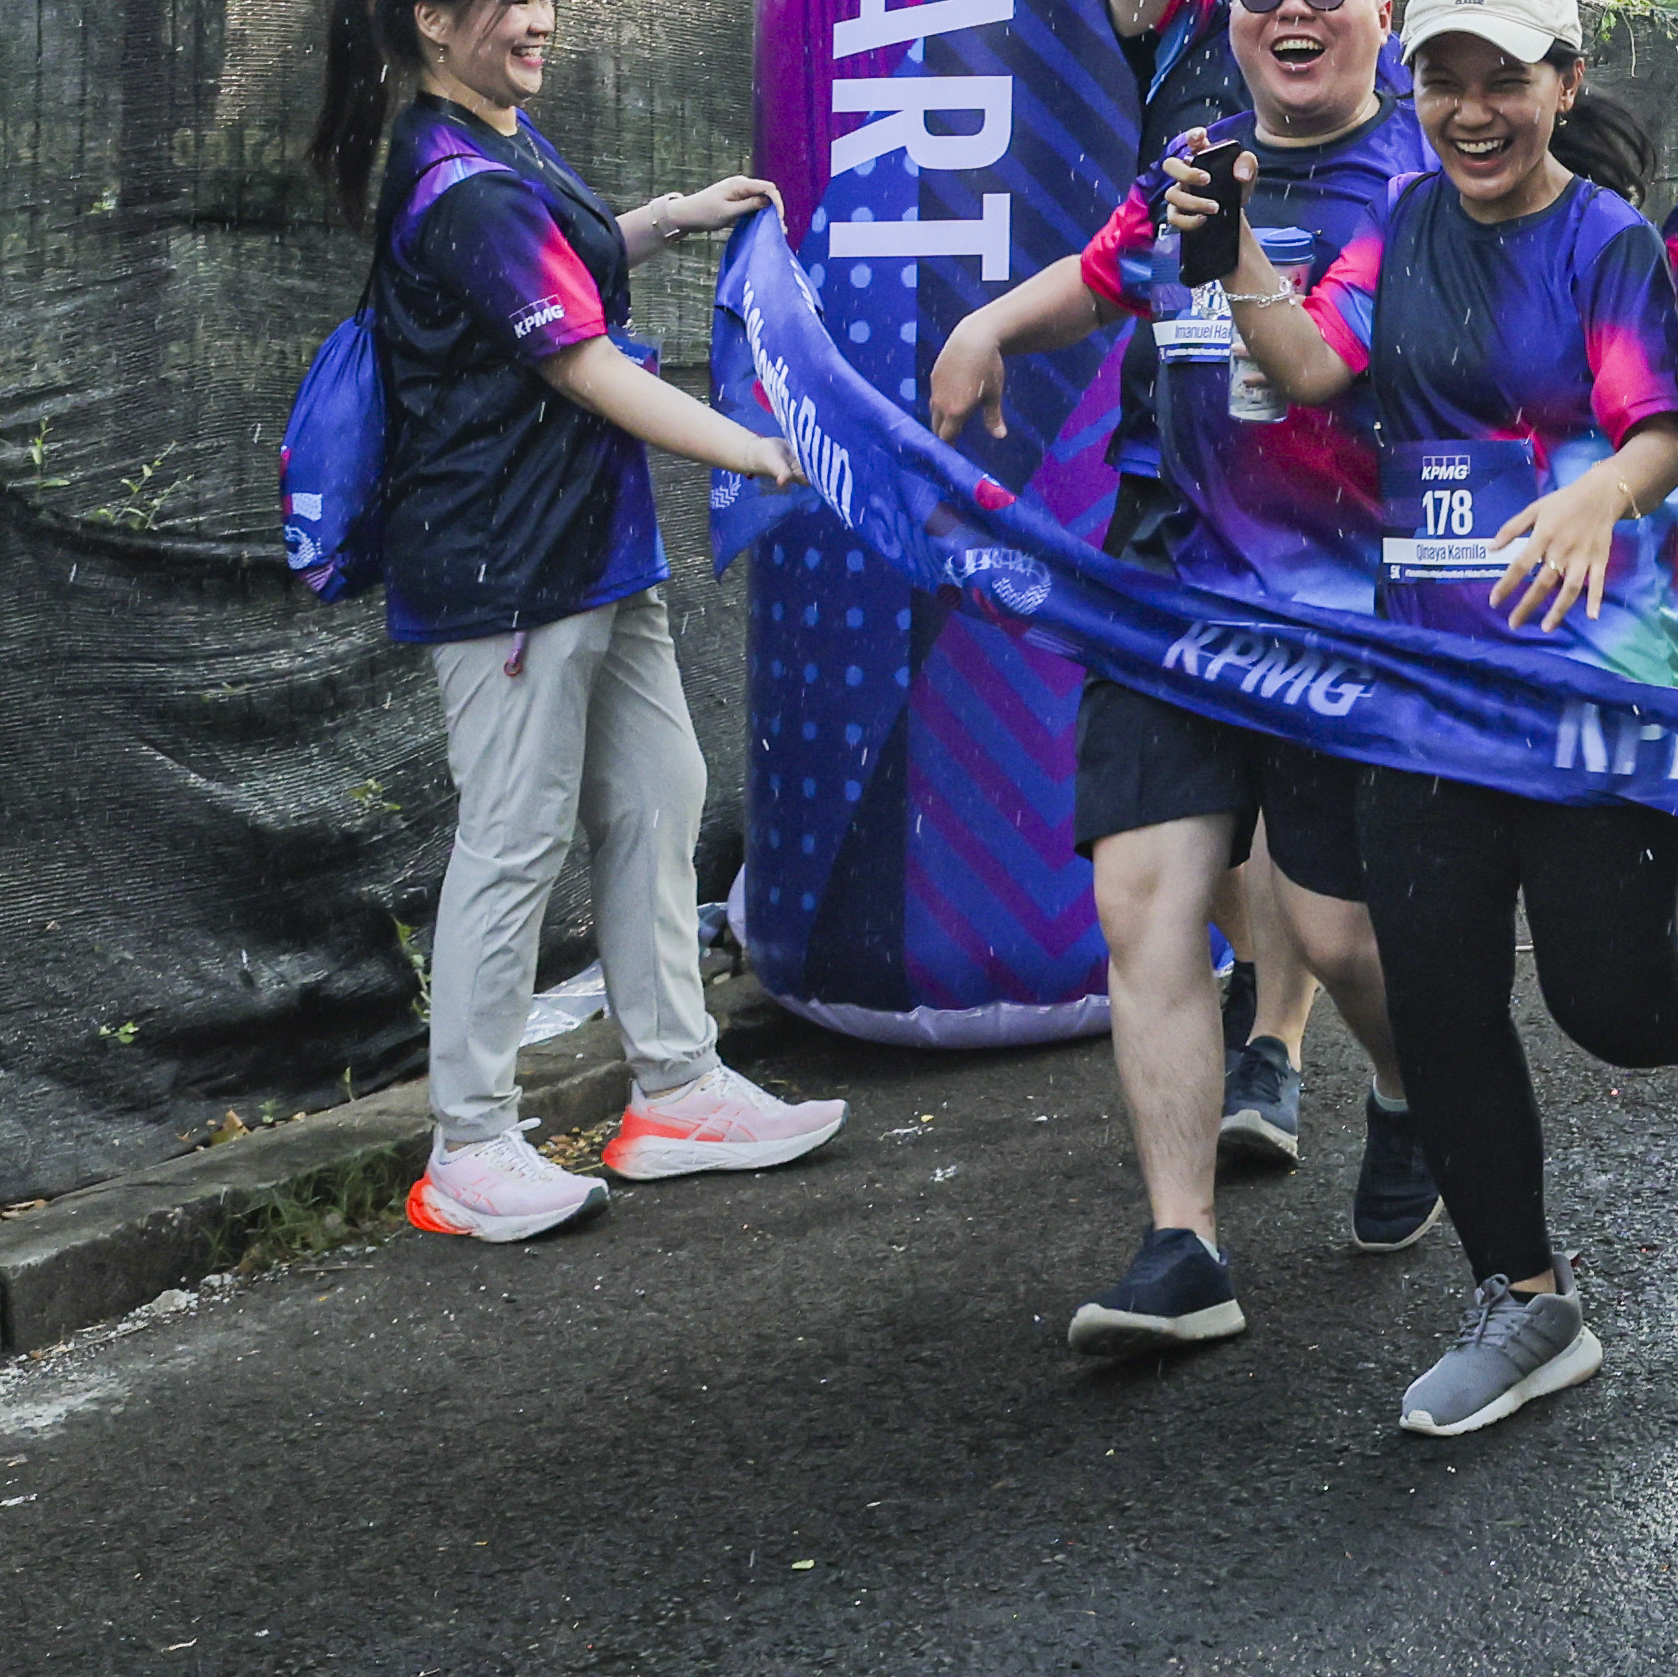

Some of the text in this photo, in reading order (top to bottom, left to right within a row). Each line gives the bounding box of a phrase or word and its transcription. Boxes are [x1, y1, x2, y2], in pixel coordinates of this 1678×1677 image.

[513, 304, 565, 339] KPMG
[1421, 464, 1470, 481] KPMG
[1421, 489, 1474, 536] 178
[1447, 544, 1487, 561] Kamila
[1161, 621, 1376, 717] KPMG
